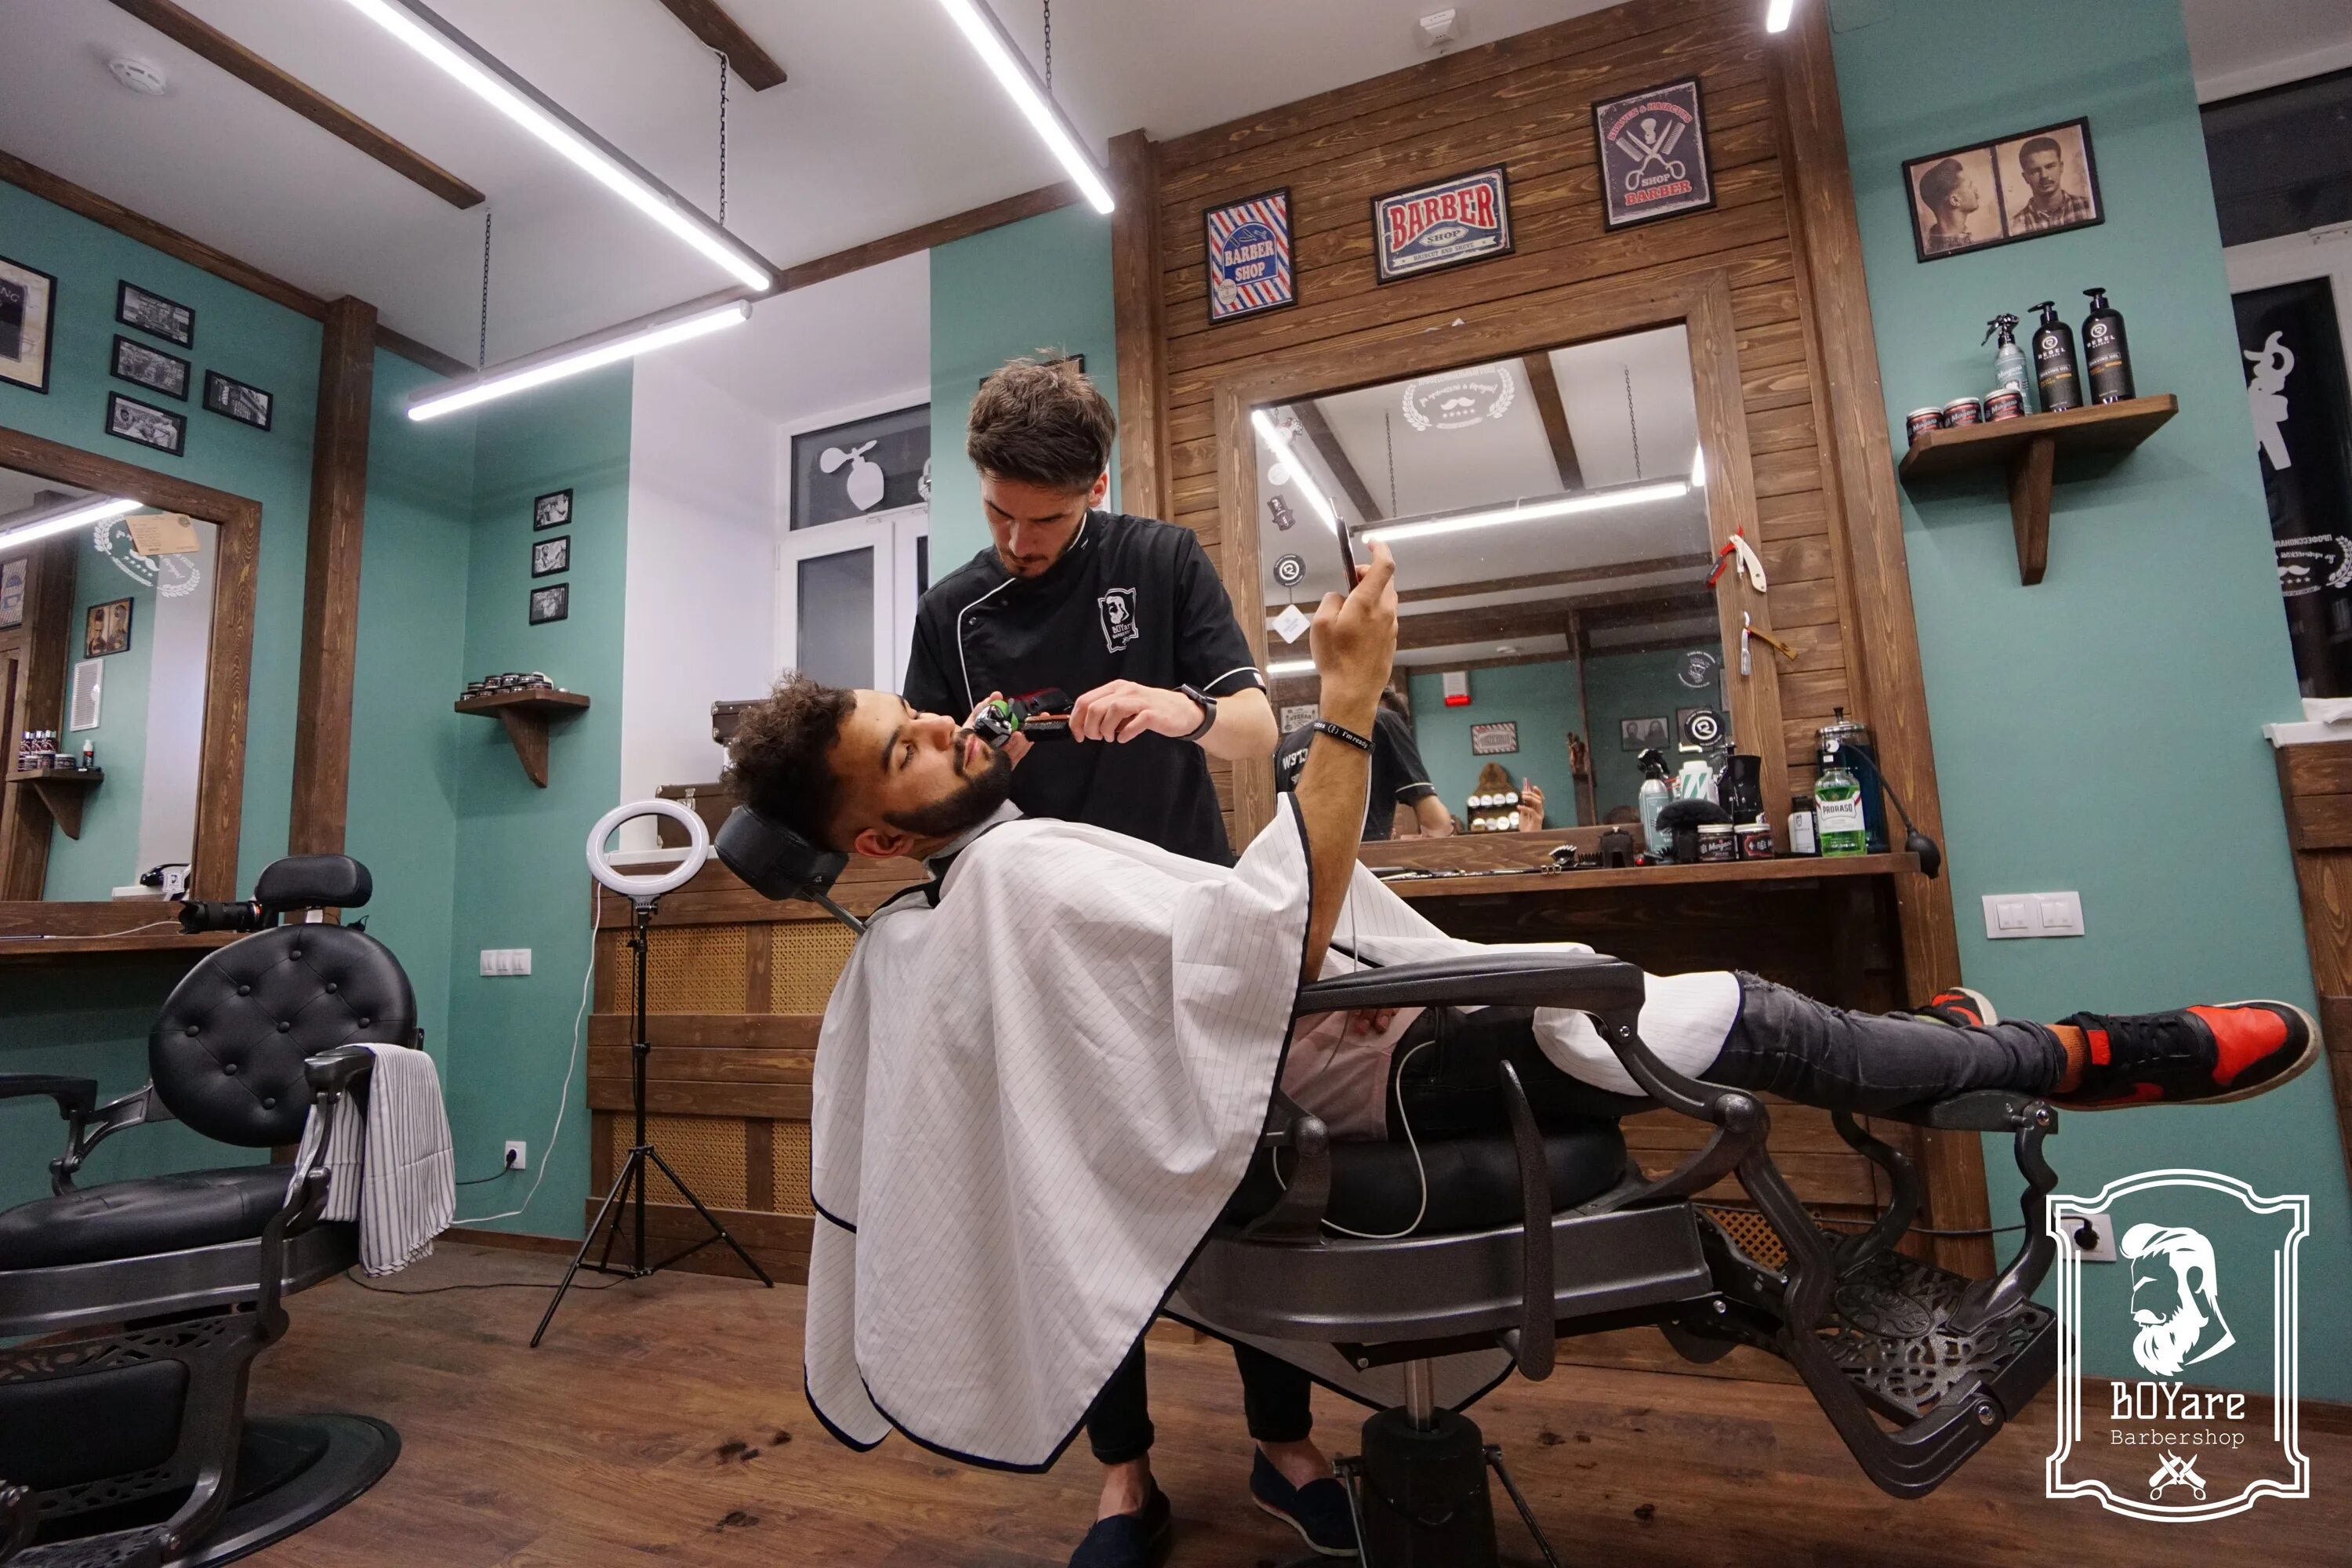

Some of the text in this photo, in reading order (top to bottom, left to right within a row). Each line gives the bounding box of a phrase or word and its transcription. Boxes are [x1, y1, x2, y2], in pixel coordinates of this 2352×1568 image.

[1647, 102, 1693, 123] HAIRCUTS
[1642, 173, 1671, 187] SHOP
[1625, 180, 1692, 205] BARBER
[1389, 183, 1497, 252] BARBER
[1427, 230, 1461, 243] SHOP
[1224, 240, 1275, 267] BARBER
[1414, 242, 1475, 261] HAIRCUT AND SHAVE
[1235, 262, 1265, 281] SHOP
[2087, 335, 2115, 348] REBEL
[2038, 347, 2066, 359] REBEL
[1112, 624, 1132, 633] BOYar
[1342, 731, 1353, 740] I'm
[1352, 737, 1368, 749] ready
[1823, 804, 1853, 815] PRORASO
